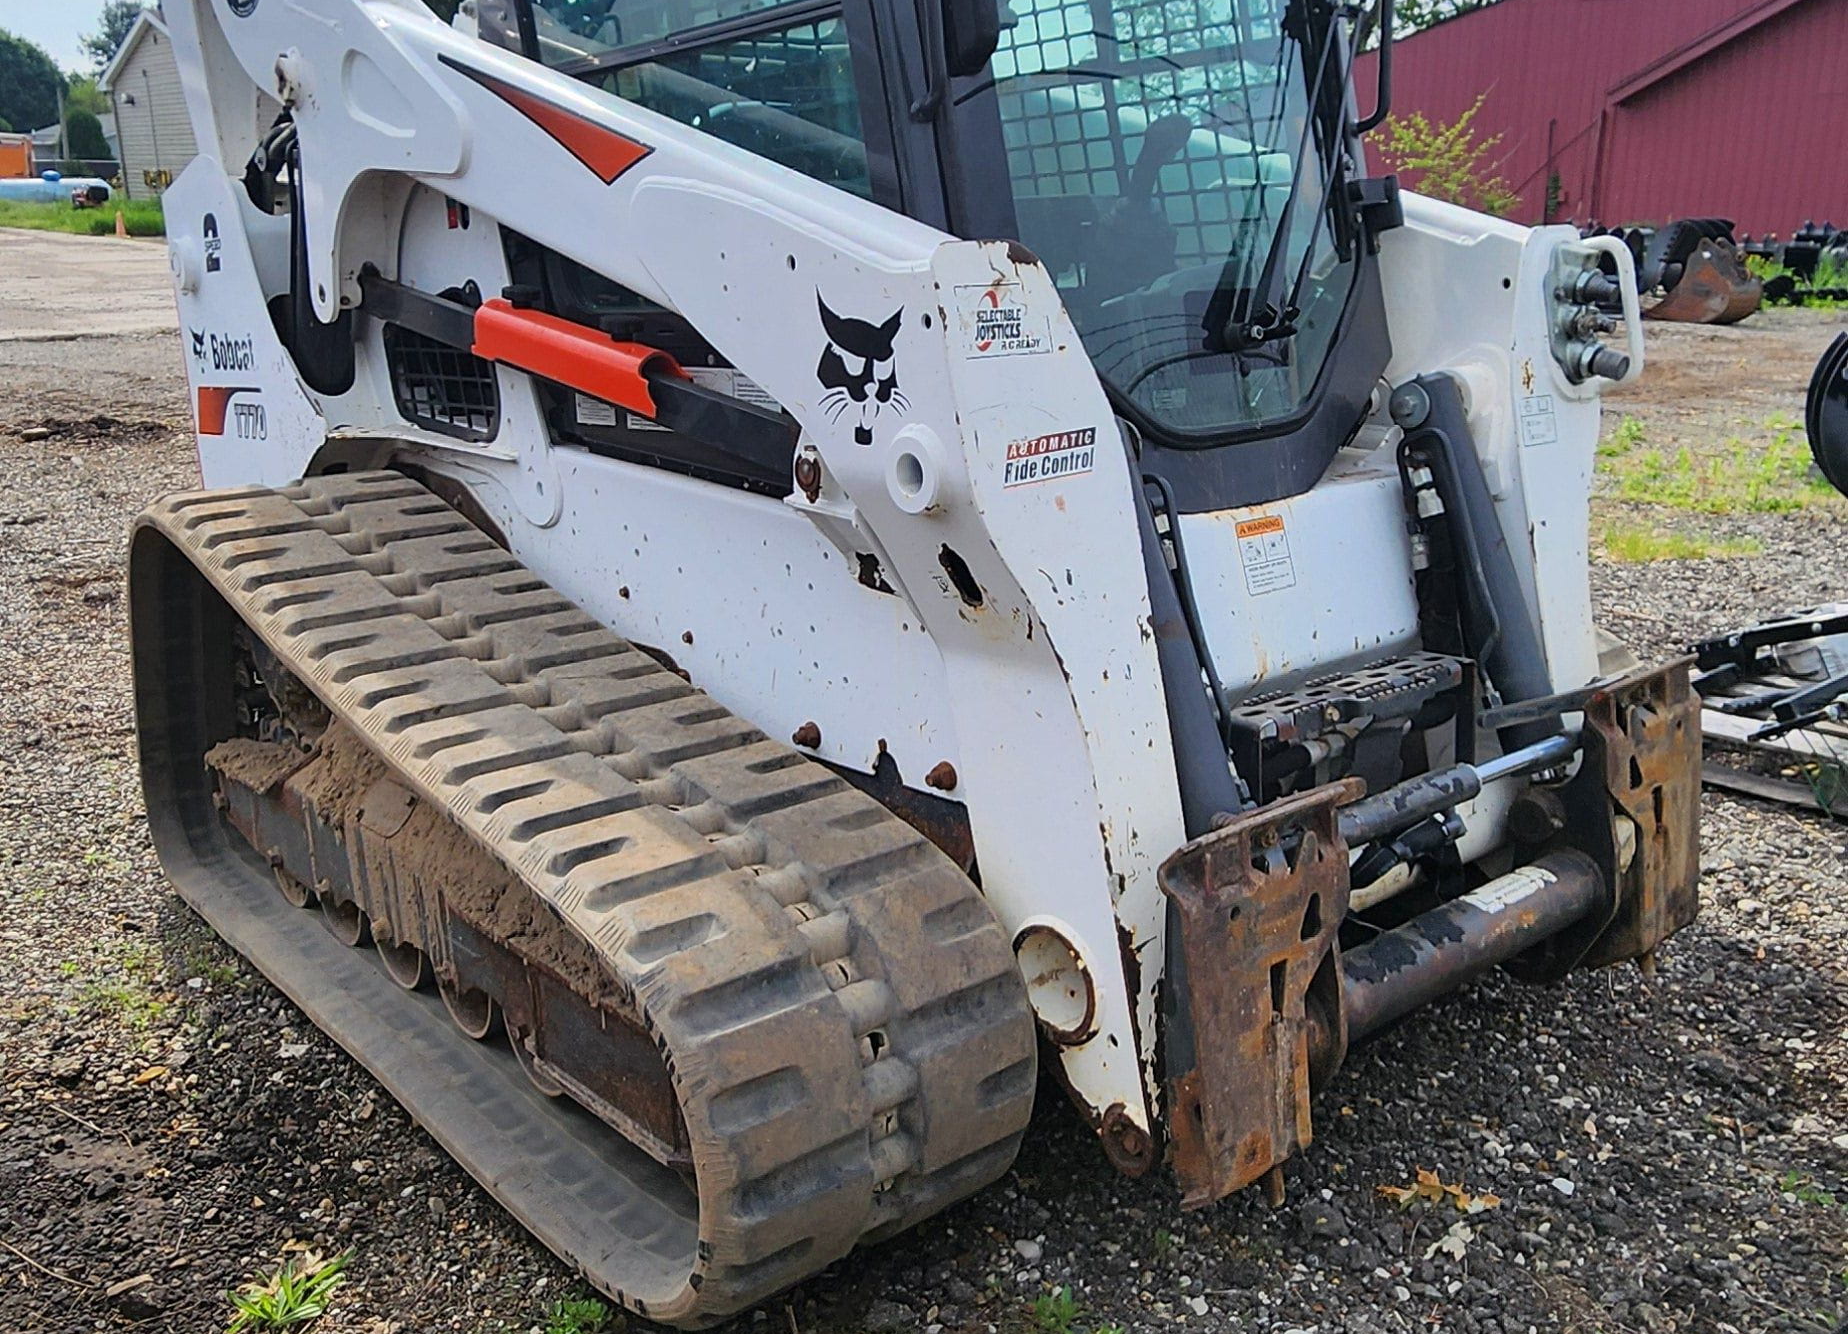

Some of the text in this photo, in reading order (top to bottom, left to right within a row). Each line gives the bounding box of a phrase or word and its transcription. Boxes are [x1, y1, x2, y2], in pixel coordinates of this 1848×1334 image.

[976, 307, 1021, 323] SELECTABLE
[975, 323, 1021, 341] JOYSTICKS
[210, 333, 256, 371] Bobcat
[1009, 430, 1093, 458] AUTOMATIC
[1041, 447, 1094, 476] Control
[1246, 518, 1280, 533] WARNING
